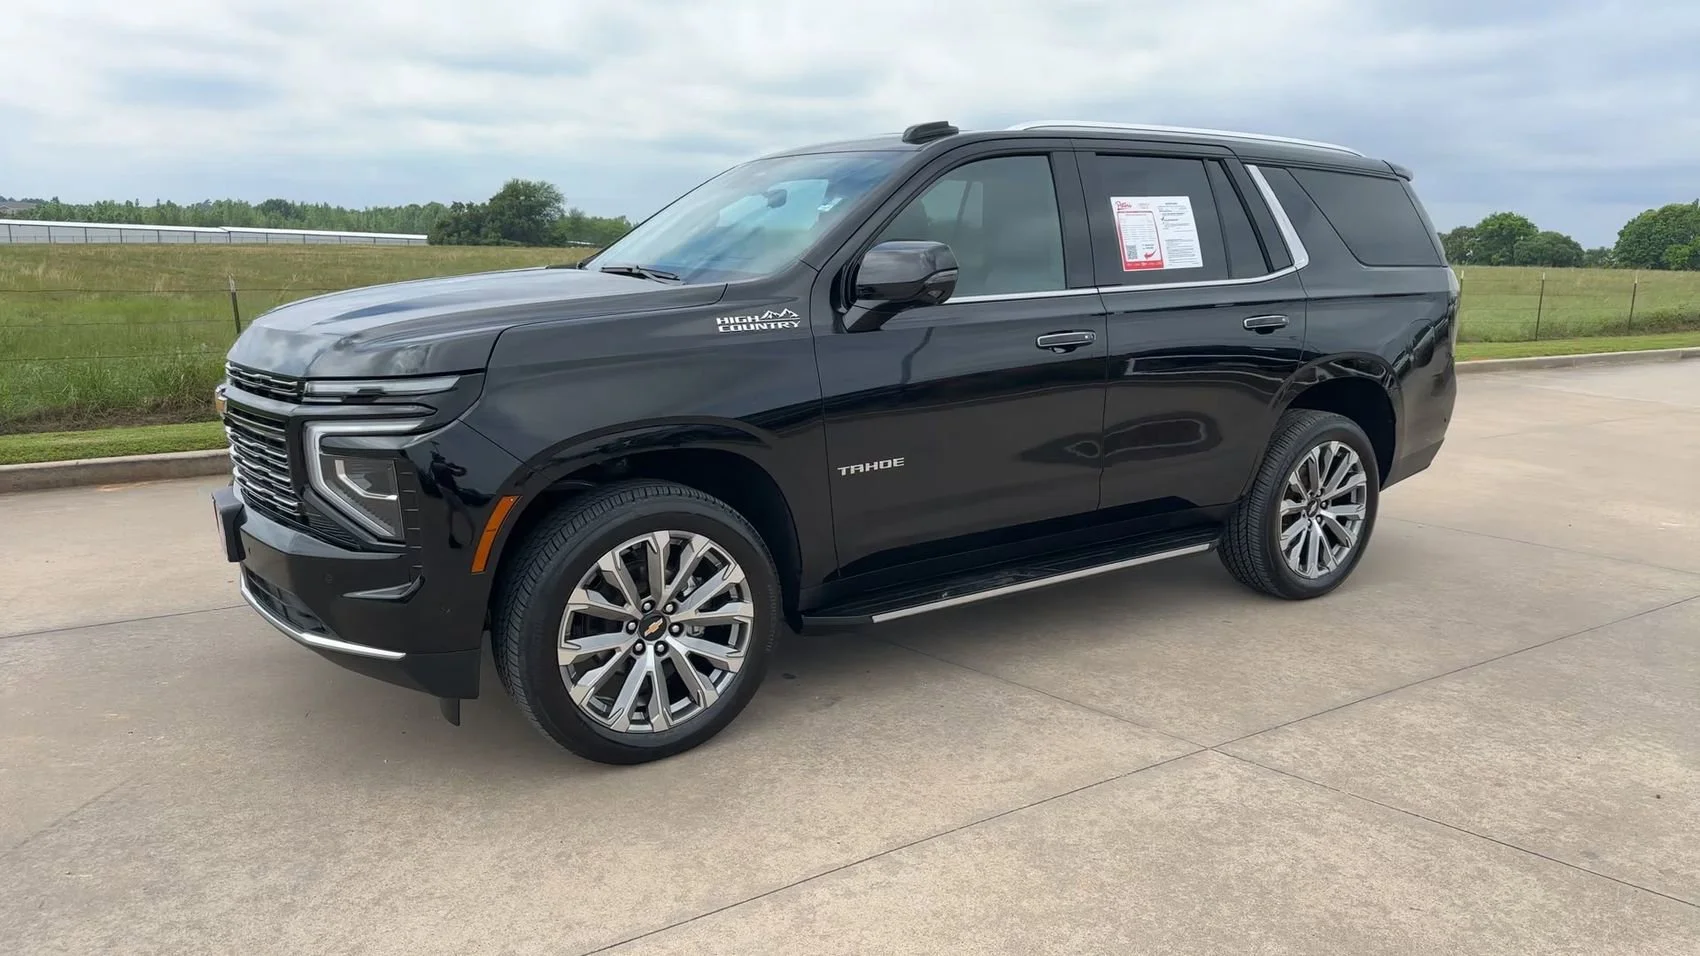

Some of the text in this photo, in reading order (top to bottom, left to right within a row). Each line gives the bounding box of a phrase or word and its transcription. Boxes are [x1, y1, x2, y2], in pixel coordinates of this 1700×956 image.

[716, 315, 761, 325] HIGH
[718, 320, 801, 332] COUNTRY
[837, 457, 905, 476] TAHOE
